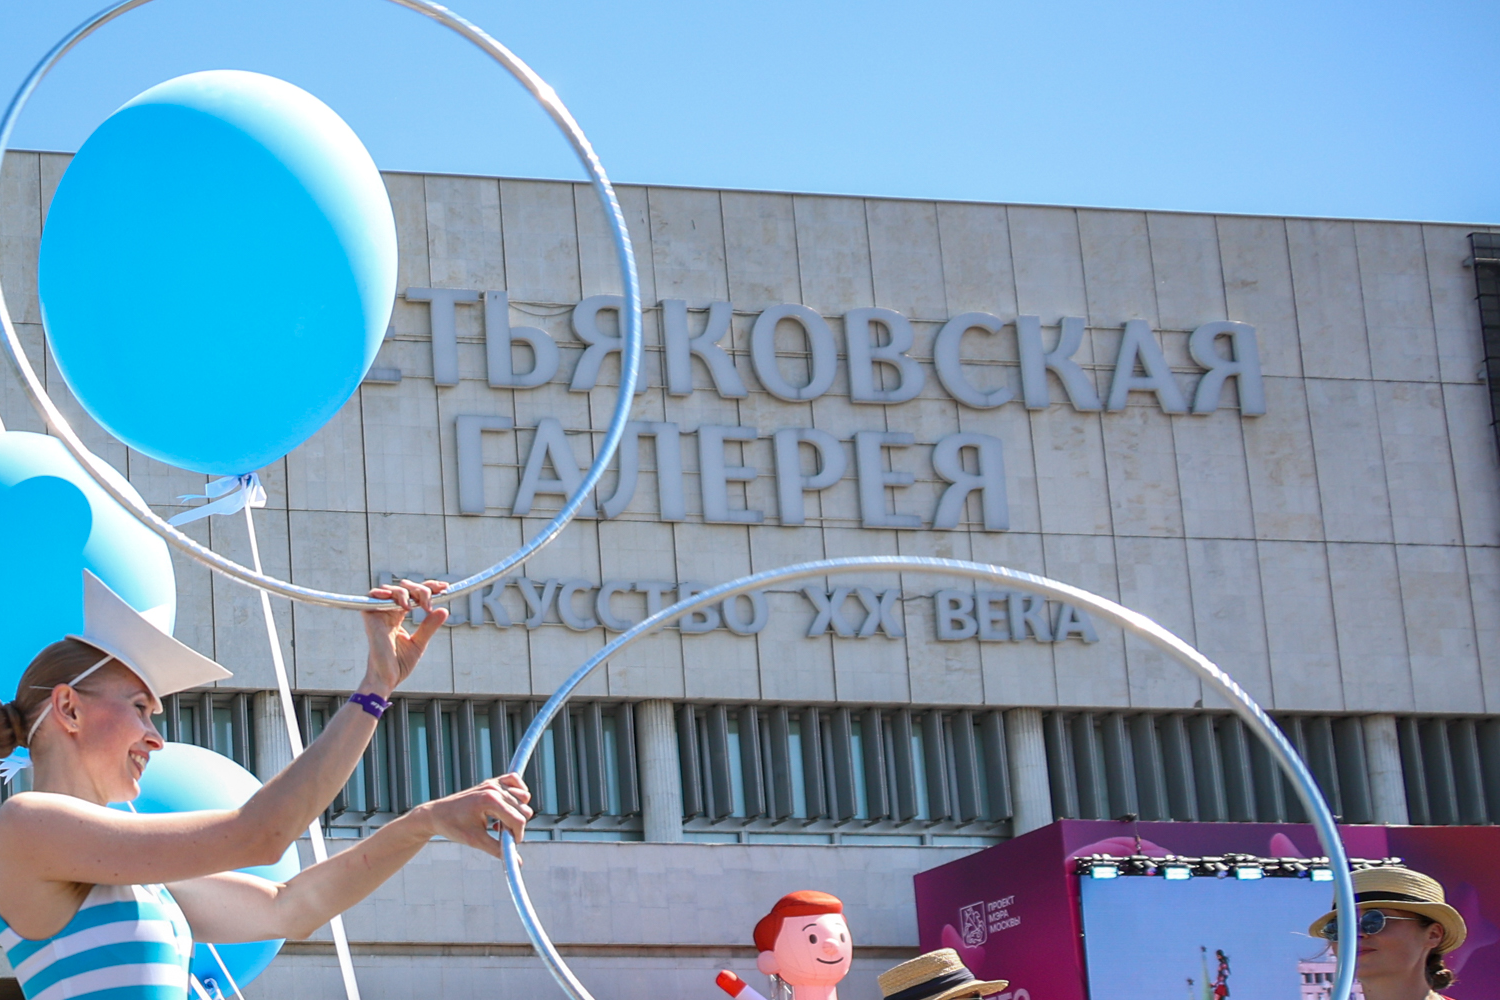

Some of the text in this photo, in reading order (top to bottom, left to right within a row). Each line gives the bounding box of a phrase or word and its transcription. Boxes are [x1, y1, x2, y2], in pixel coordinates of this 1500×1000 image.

[364, 287, 1267, 418] ТЬЯКОВСКАЯ
[455, 415, 1010, 532] ГАЛЕРЕЯ
[936, 590, 1100, 645] ВЕКА
[988, 895, 1015, 912] ПРОЕКТ
[988, 909, 1009, 923] МЭРА
[989, 916, 1021, 934] МОСКВЫ
